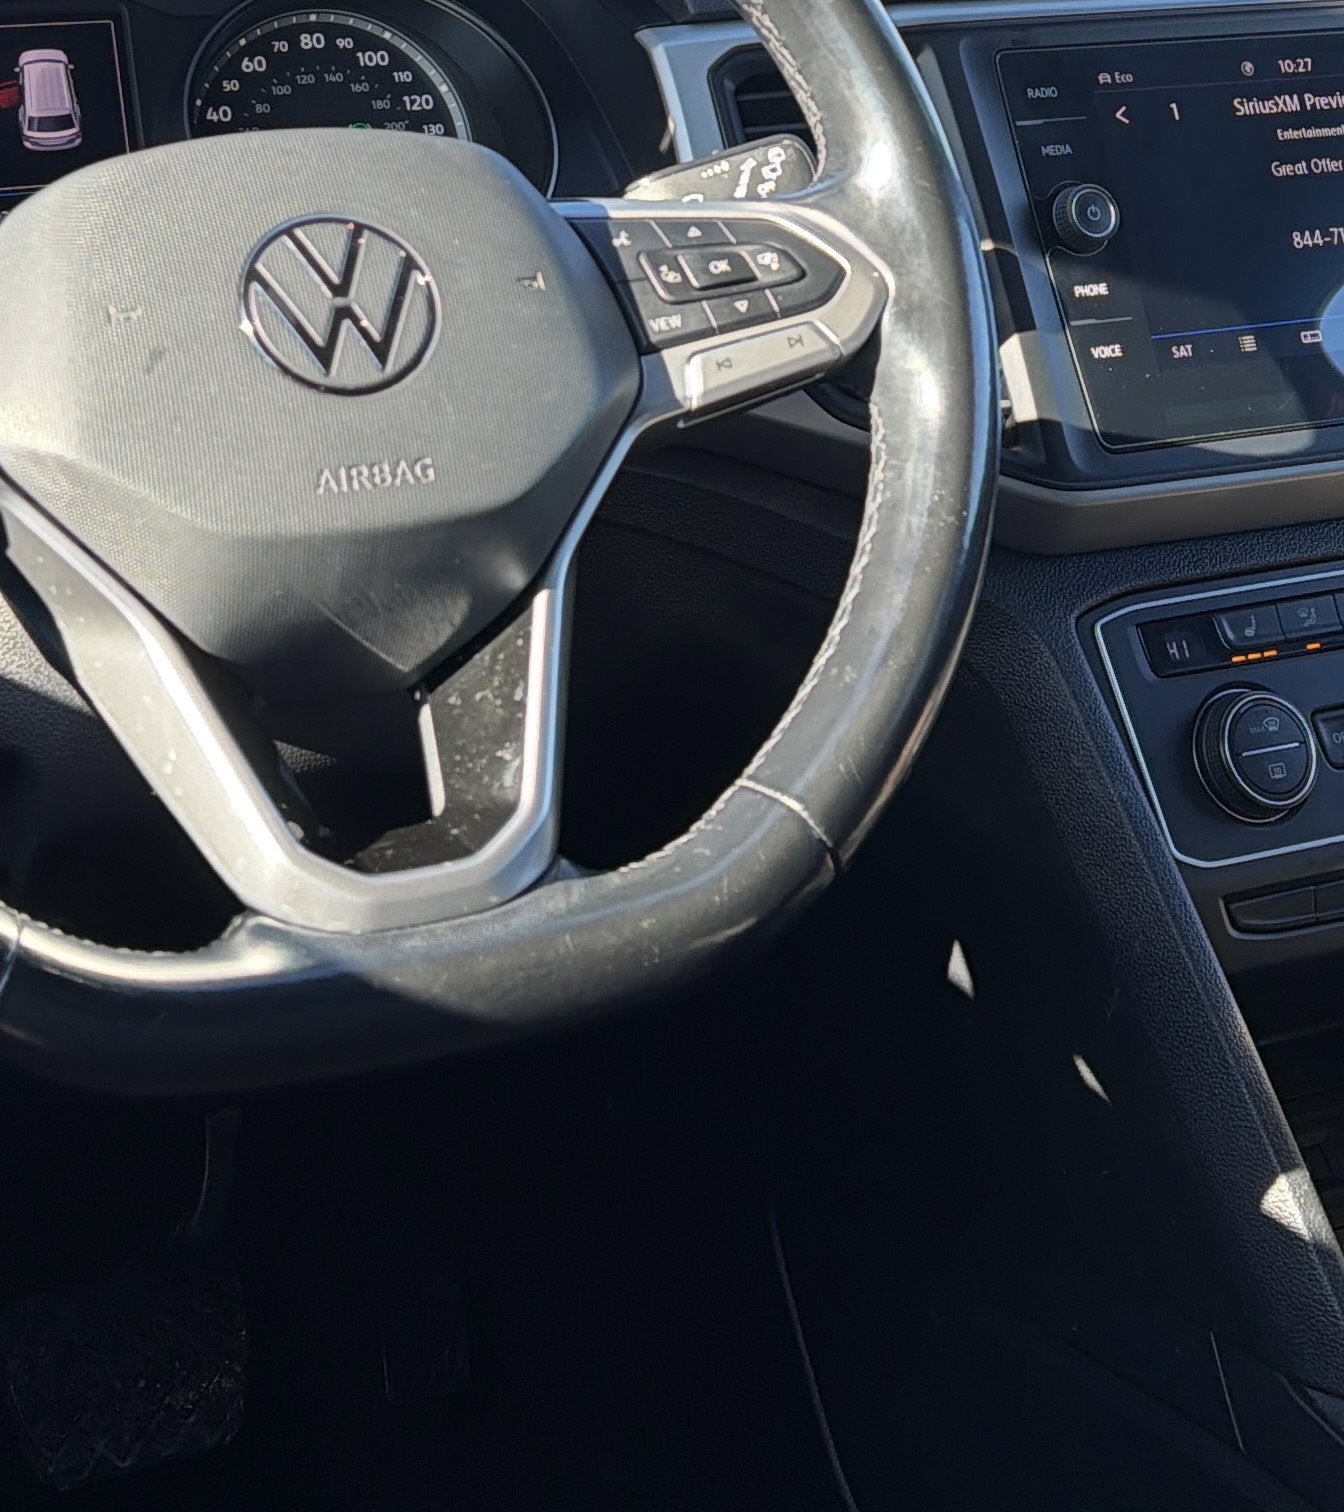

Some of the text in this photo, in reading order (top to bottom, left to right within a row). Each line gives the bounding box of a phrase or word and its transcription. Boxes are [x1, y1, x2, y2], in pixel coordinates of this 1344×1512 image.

[271, 40, 289, 53] 70
[299, 32, 325, 50] 80
[336, 37, 354, 50] 90
[241, 55, 267, 74] 60
[356, 50, 389, 67] 100
[1277, 57, 1312, 74] 10:27
[295, 73, 316, 86] 120
[324, 71, 344, 83] 140
[393, 70, 413, 84] 110
[1114, 71, 1134, 84] Eco
[222, 79, 240, 92] 50
[271, 84, 292, 96] 100
[349, 81, 370, 93] 160
[1027, 86, 1058, 100] RADIO
[255, 102, 271, 114] 80
[371, 98, 391, 111] 180
[403, 94, 434, 112] 120
[1233, 93, 1301, 117] SiriusXM
[206, 105, 232, 123] 40
[1169, 102, 1181, 121] 1
[422, 122, 445, 136] 130
[1041, 143, 1073, 157] MEDIA
[1271, 160, 1308, 177] Great
[1310, 156, 1344, 174] Offer
[708, 259, 732, 274] OK
[1073, 282, 1110, 298] PHONE
[1089, 343, 1123, 359] VOICE
[1171, 343, 1194, 359] SAT
[316, 457, 436, 495] AIRBAG
